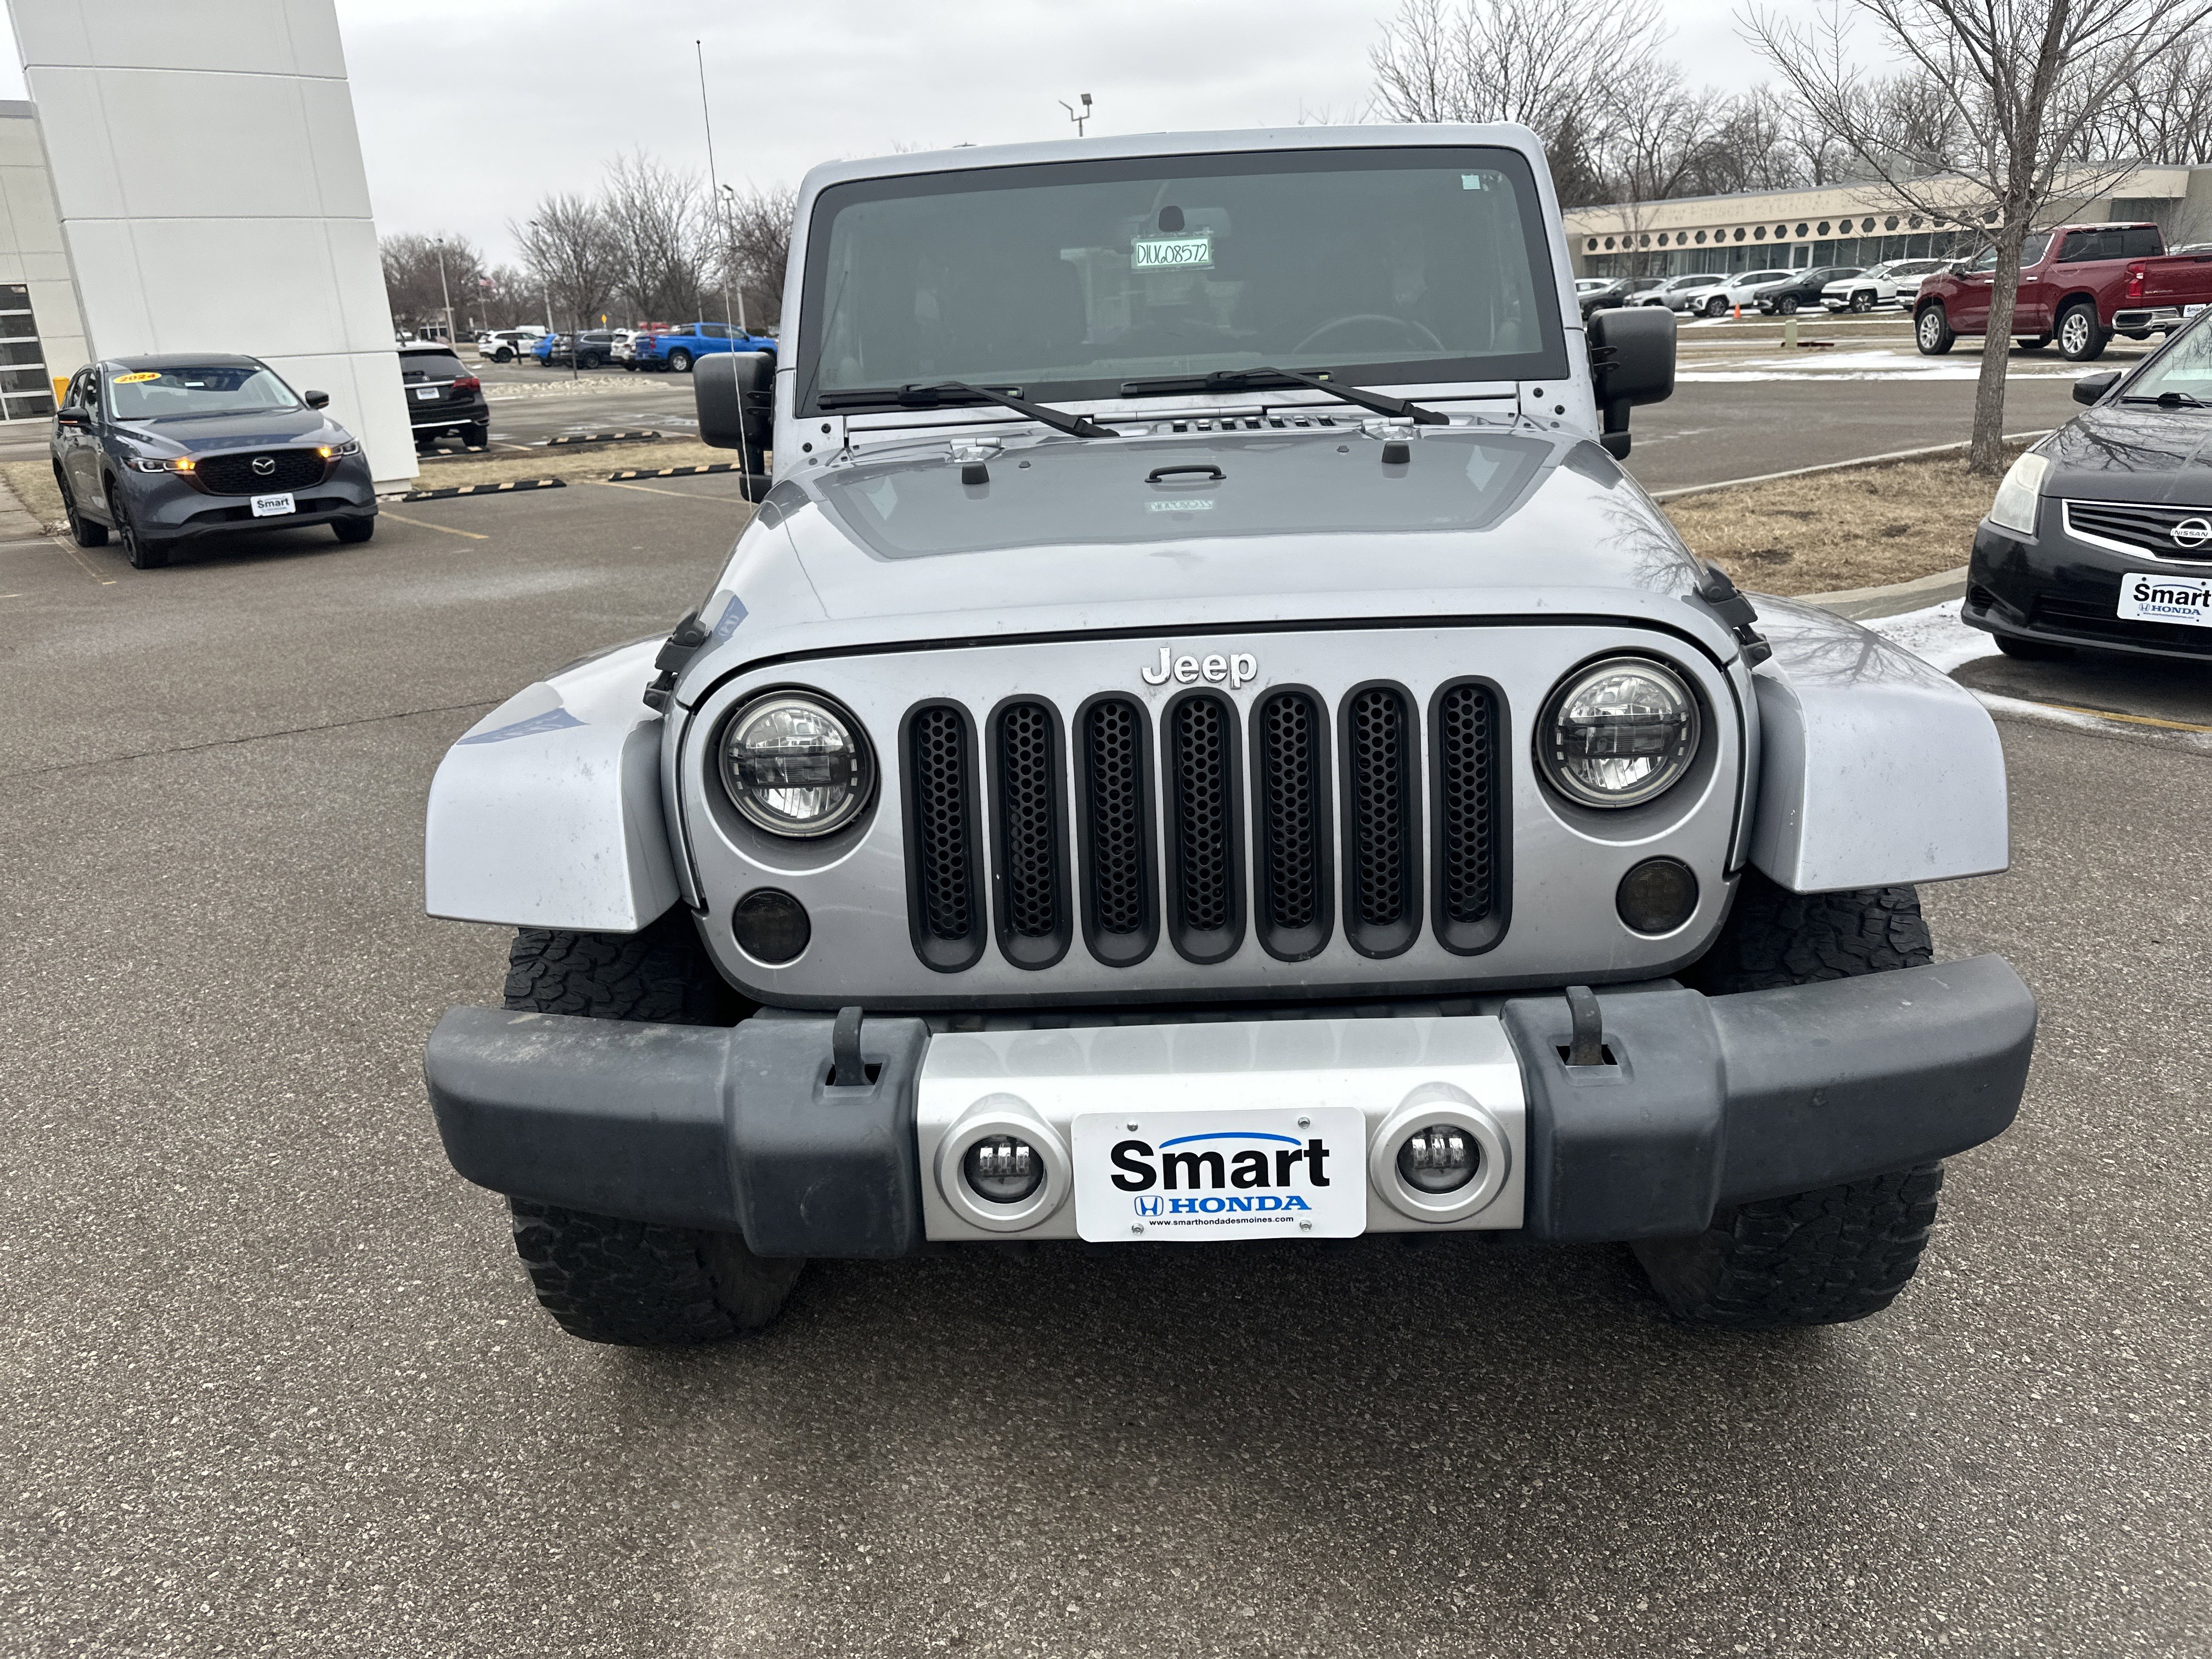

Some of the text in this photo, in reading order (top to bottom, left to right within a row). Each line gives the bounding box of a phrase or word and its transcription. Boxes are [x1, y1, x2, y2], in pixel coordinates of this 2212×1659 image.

[120, 374, 156, 382] 2024
[257, 498, 289, 509] Smart
[2133, 583, 2211, 607] Smart
[2151, 605, 2202, 616] HONDA
[1141, 647, 1258, 690] Jeep
[1110, 1139, 1330, 1192] Smart
[1169, 1195, 1312, 1214] HONDA
[1149, 1216, 1294, 1226] www.smarthondadesmoines.com
